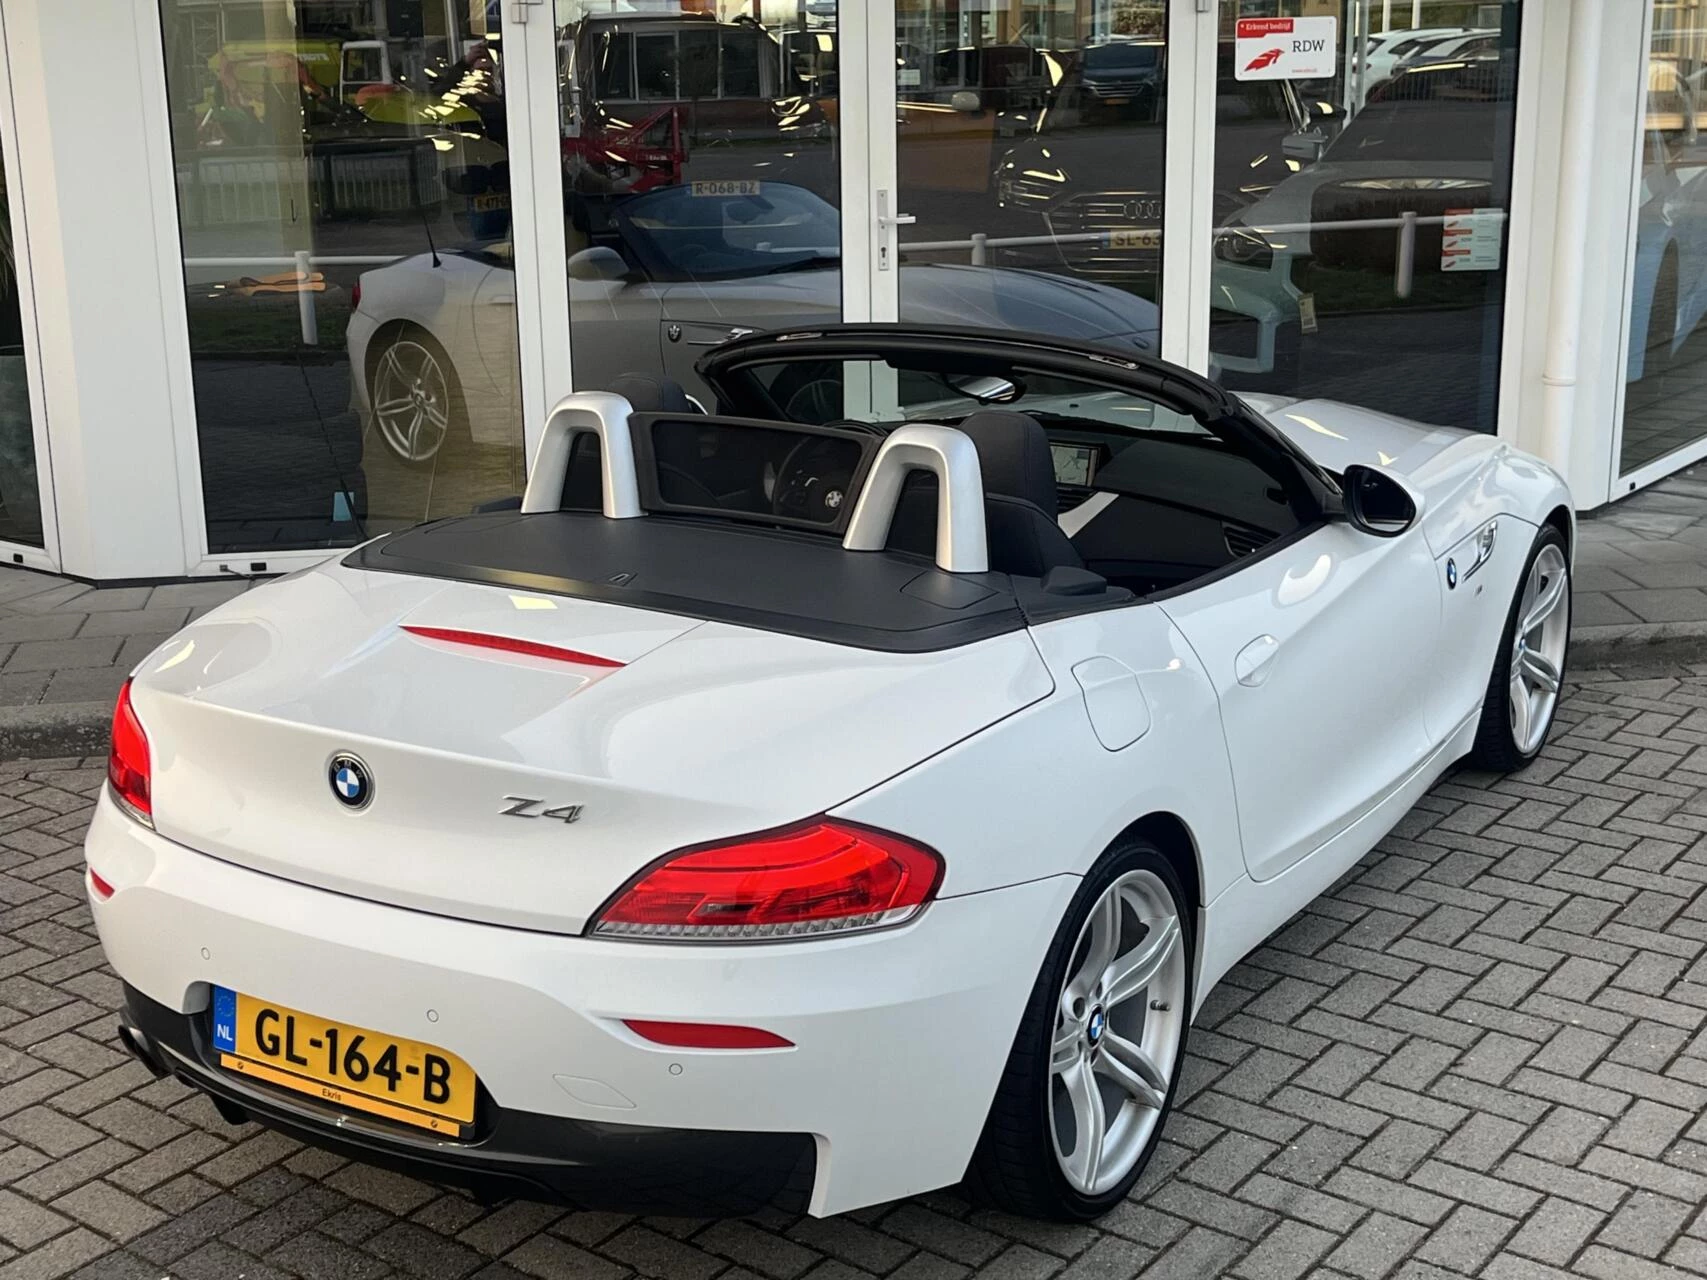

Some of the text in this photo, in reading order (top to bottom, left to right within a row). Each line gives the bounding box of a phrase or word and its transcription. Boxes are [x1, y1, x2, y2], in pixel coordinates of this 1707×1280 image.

[1292, 39, 1325, 53] RDW
[498, 795, 584, 824] Z4
[217, 1024, 234, 1041] NL
[255, 1008, 451, 1105] GL-164-B
[321, 1088, 342, 1101] Ekris
